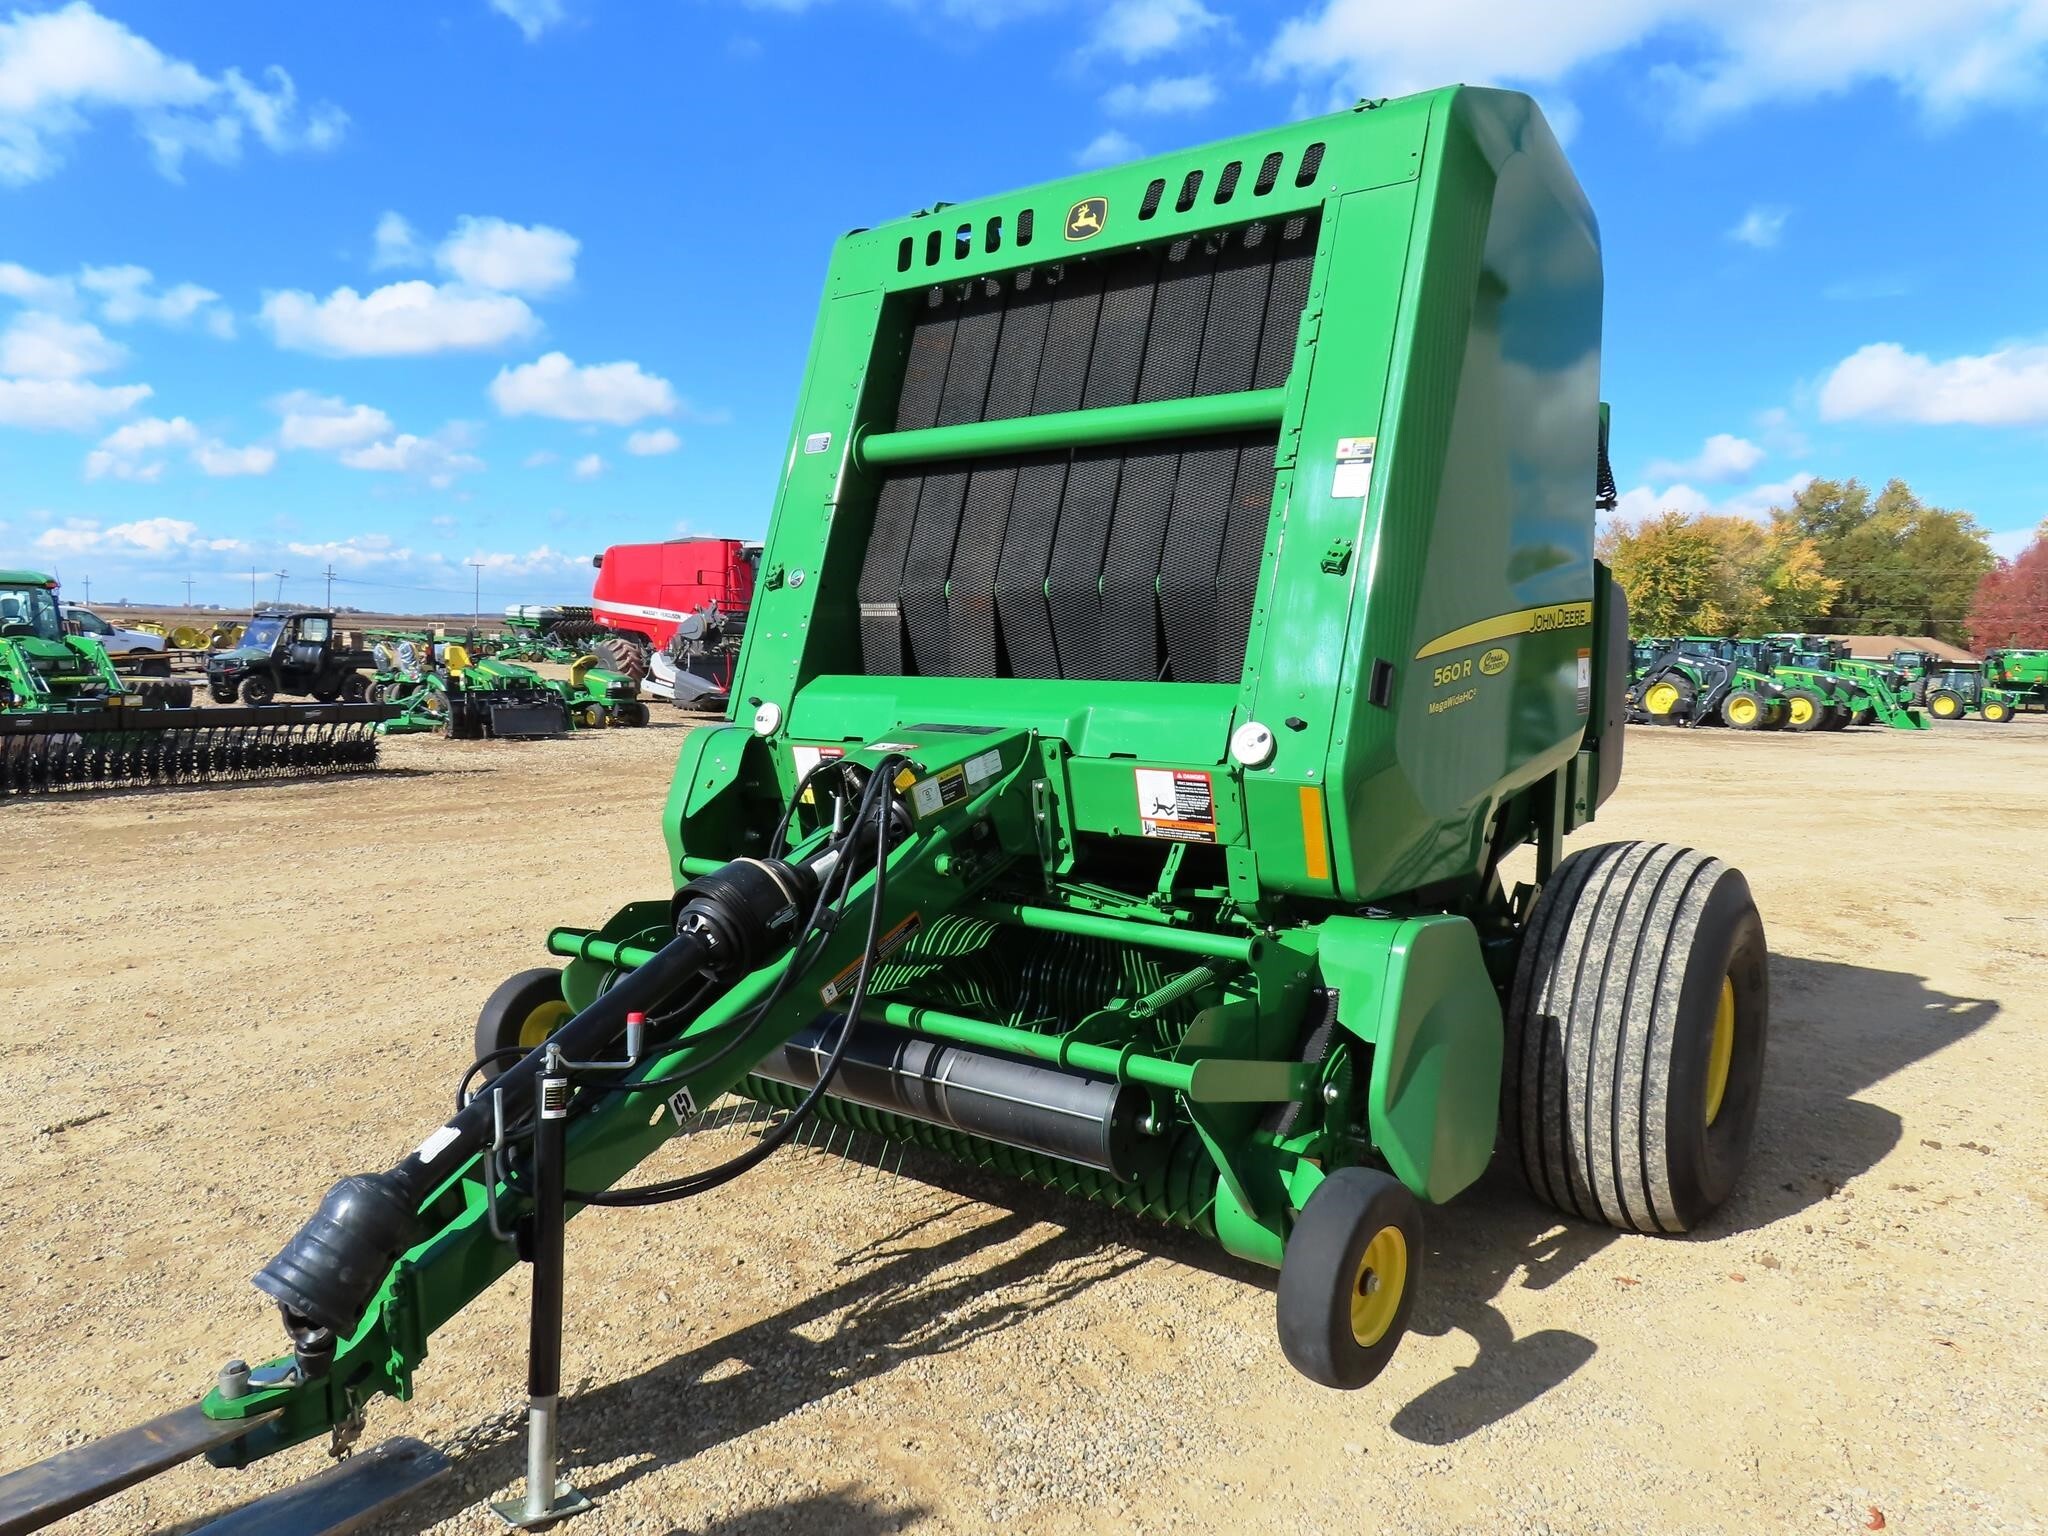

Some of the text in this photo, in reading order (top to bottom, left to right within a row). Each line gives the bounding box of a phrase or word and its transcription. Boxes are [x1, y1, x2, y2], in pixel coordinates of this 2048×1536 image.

[1530, 609, 1586, 632] JOHN DEERE
[1433, 659, 1472, 687] 560 R
